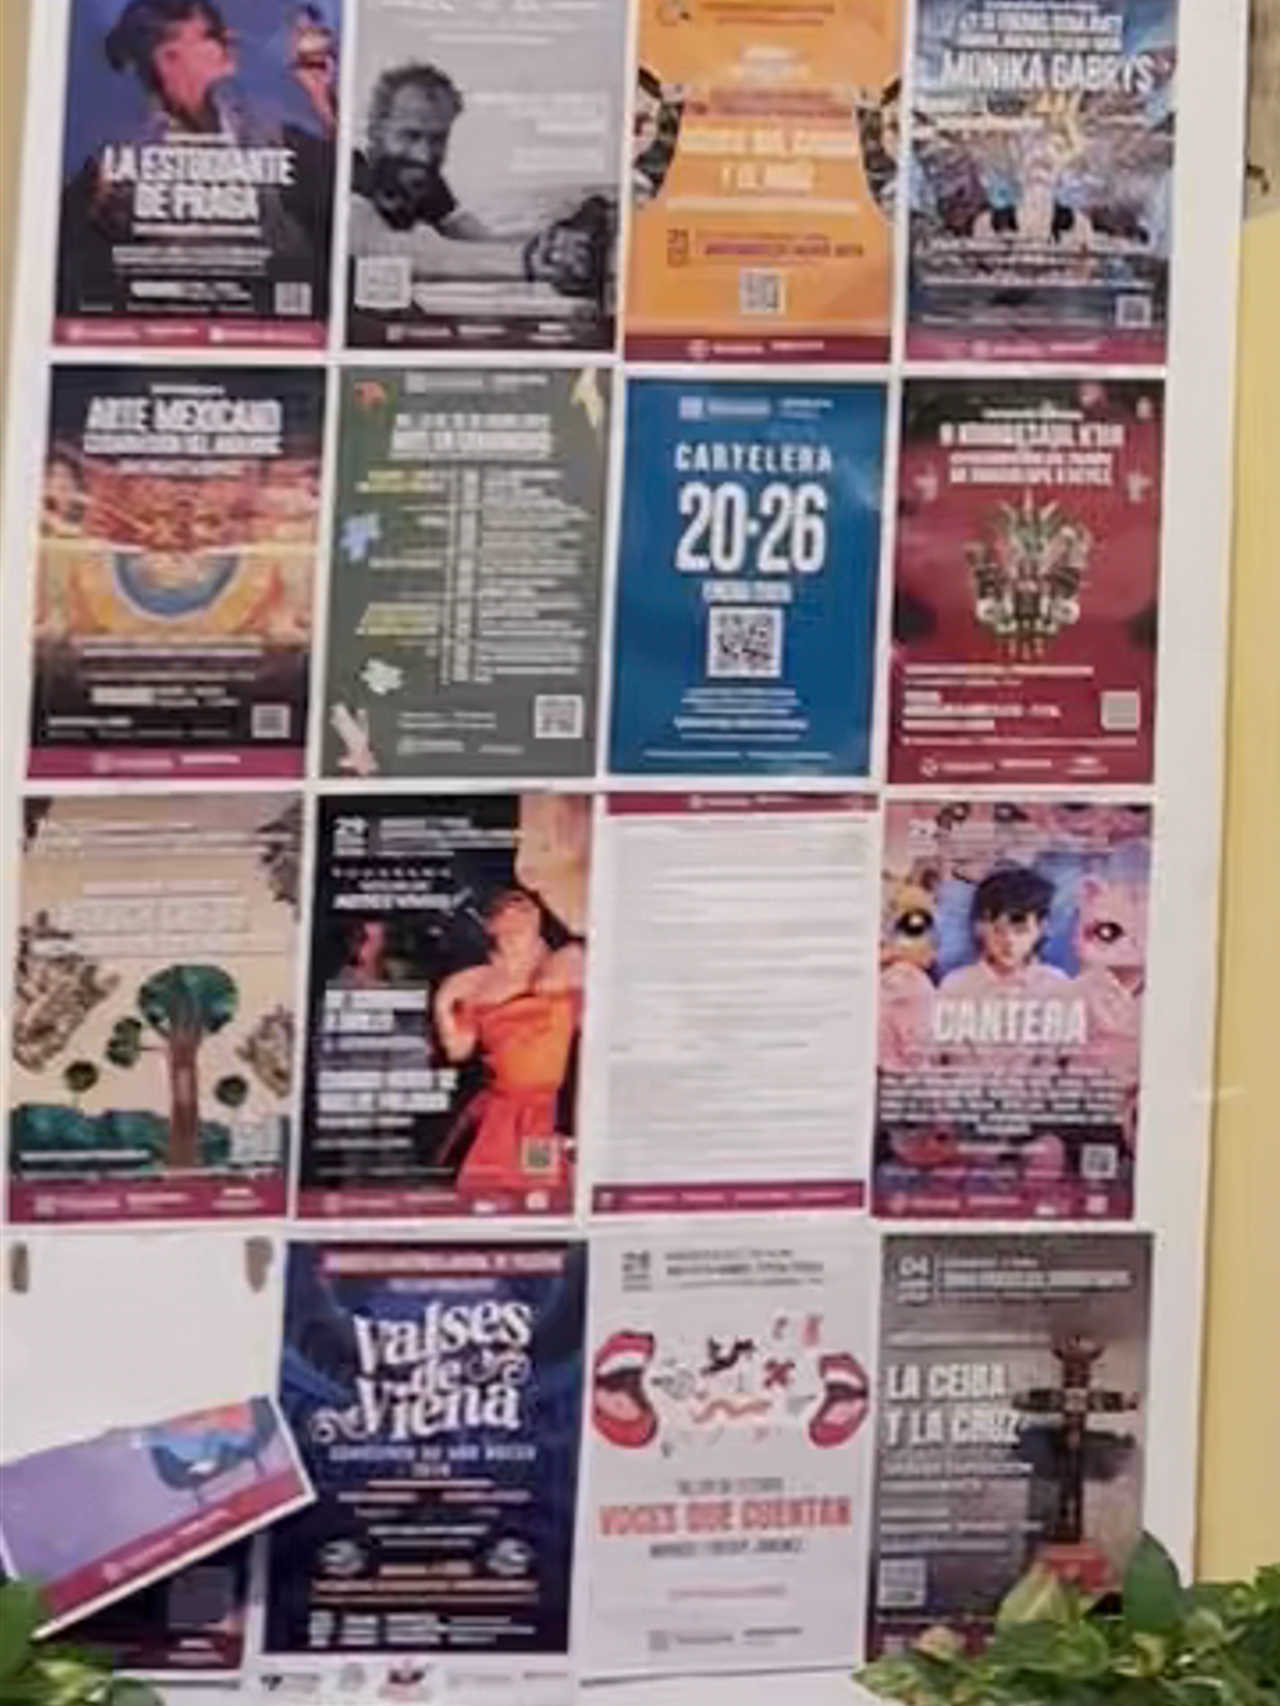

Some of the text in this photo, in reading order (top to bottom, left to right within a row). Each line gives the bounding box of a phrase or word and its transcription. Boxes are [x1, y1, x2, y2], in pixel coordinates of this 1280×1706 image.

[674, 441, 832, 473] CARTELERA
[934, 997, 1087, 1045] CANTERA
[353, 1298, 533, 1376] Valses
[411, 1355, 464, 1399] de
[886, 1363, 920, 1400] LA
[354, 1375, 522, 1443] Viena
[909, 1412, 943, 1446] LA
[949, 1412, 1022, 1447] CRUZ
